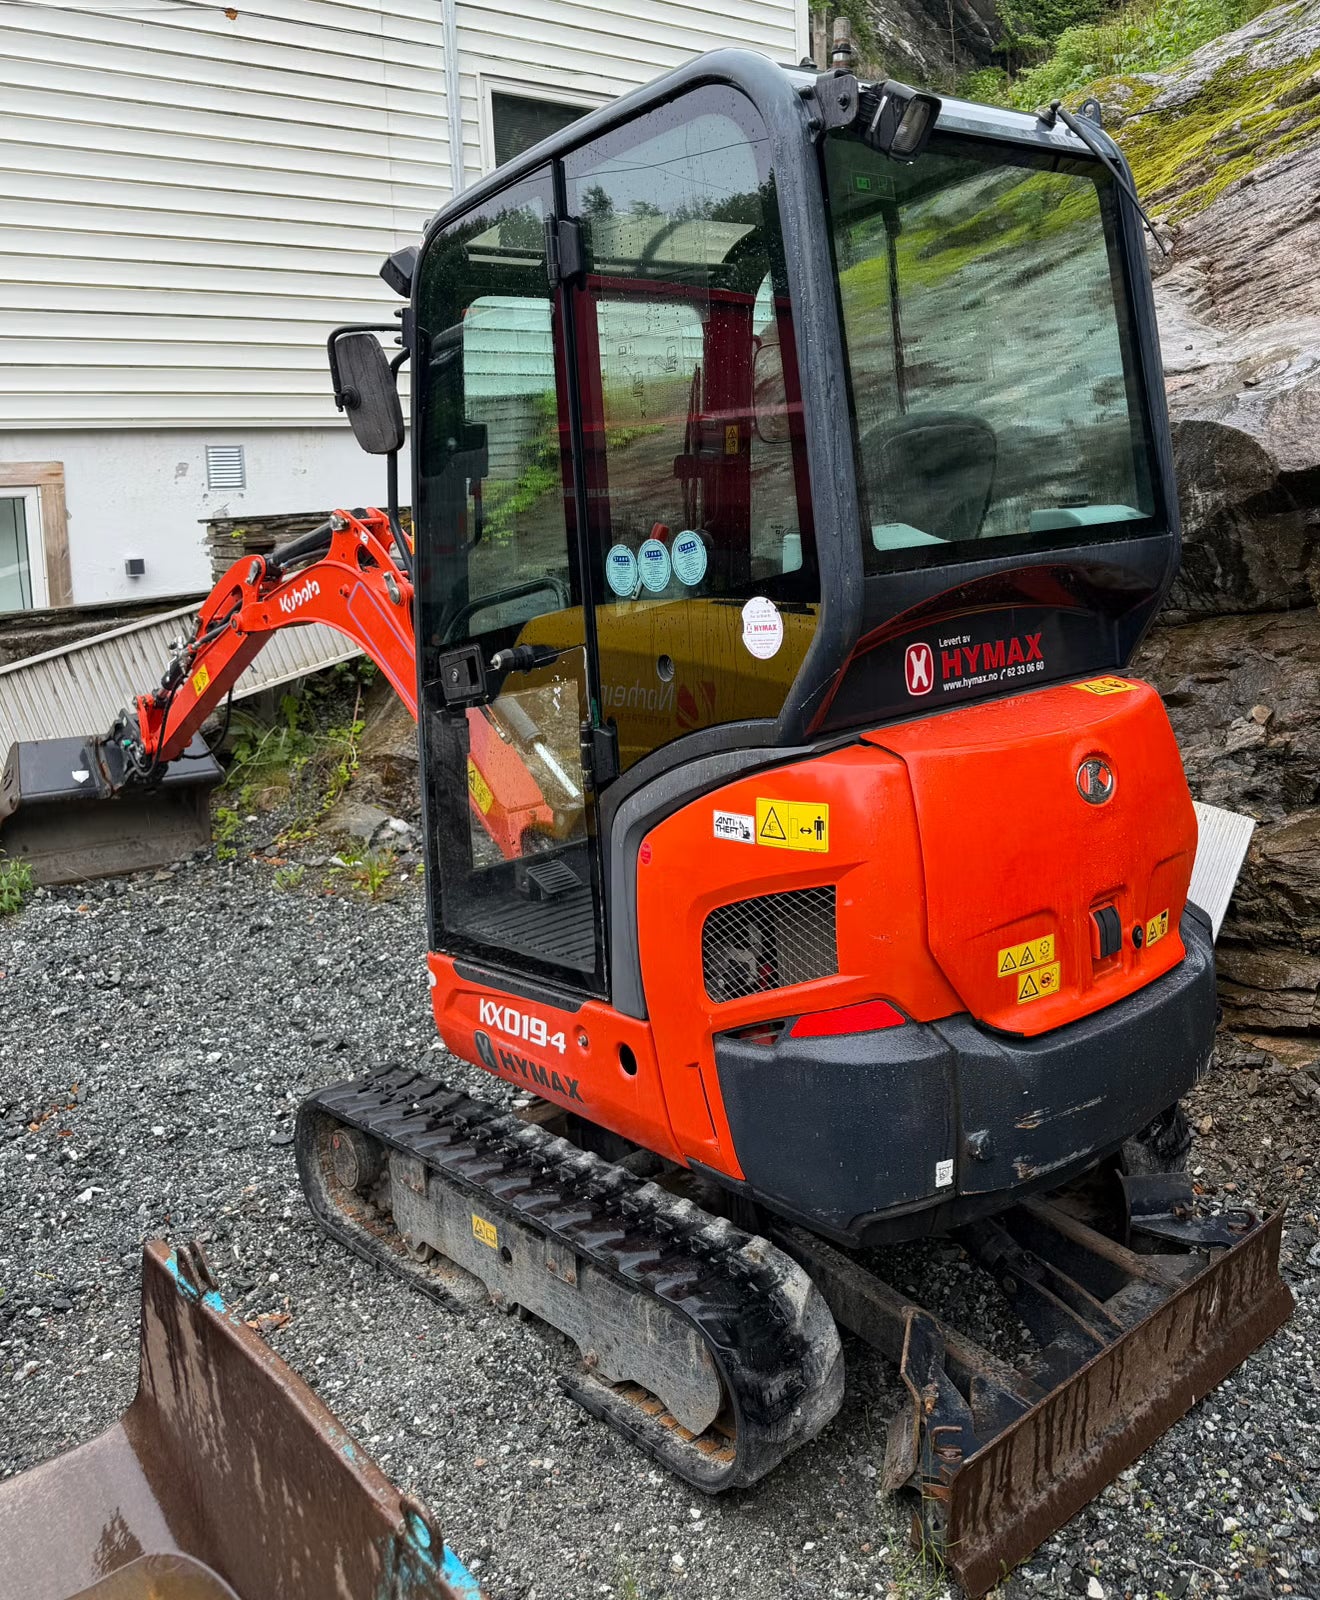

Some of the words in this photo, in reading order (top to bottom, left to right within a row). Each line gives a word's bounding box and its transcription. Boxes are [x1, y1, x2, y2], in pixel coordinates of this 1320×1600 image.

[279, 579, 321, 614] Kubota
[938, 635, 961, 648] Levert
[962, 635, 971, 643] av
[941, 632, 1044, 680] HYMAX
[943, 672, 998, 691] www.hymax.no
[1007, 667, 1016, 678] 62
[1016, 664, 1026, 676] 33
[1026, 662, 1036, 674] 06
[1036, 660, 1045, 671] 60
[715, 823, 740, 836] THEFT
[498, 1048, 585, 1104] HYMAX
